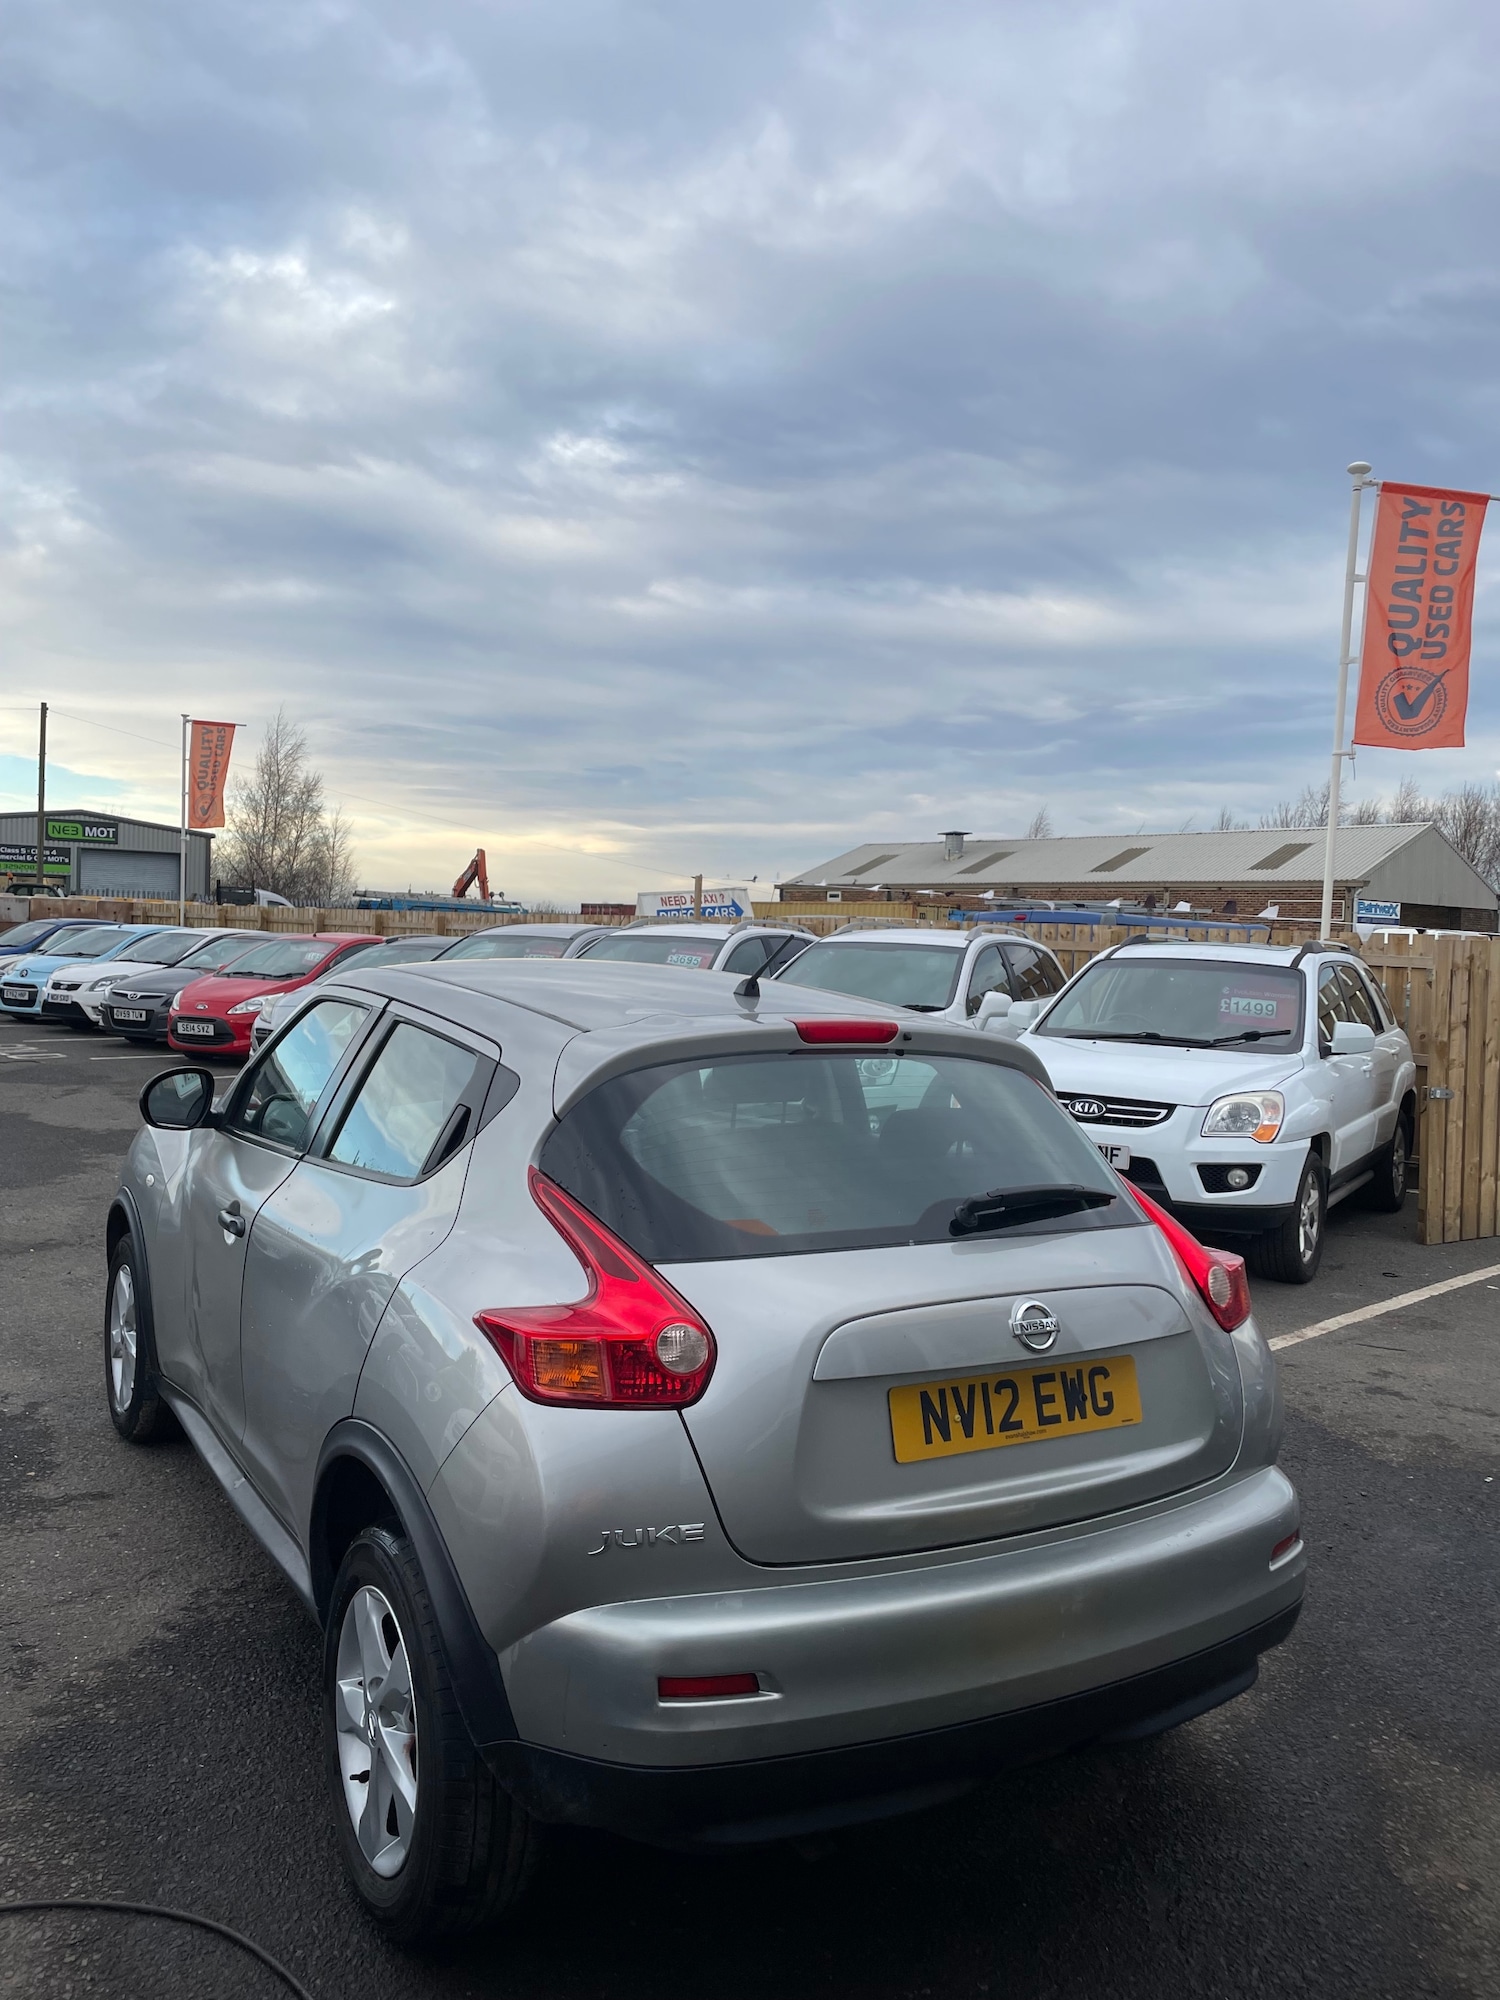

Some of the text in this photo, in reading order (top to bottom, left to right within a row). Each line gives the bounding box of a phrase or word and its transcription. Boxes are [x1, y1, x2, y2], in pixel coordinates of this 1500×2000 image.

[1387, 497, 1432, 657] QUALITY
[1420, 501, 1466, 660] USED CARS
[1380, 683, 1390, 713] QUALITY
[197, 727, 214, 791] QUALITY
[209, 727, 226, 791] USED CARS
[84, 826, 116, 838] MOT
[660, 895, 687, 907] NEED
[701, 893, 718, 905] AXI
[706, 907, 736, 918] CARS
[1220, 999, 1275, 1016] £1499
[181, 1023, 195, 1033] SE14
[1075, 1102, 1098, 1113] KIA
[1020, 1321, 1056, 1332] NISSAN
[919, 1366, 1114, 1445] NV12 EWG
[587, 1523, 704, 1554] JUKE
